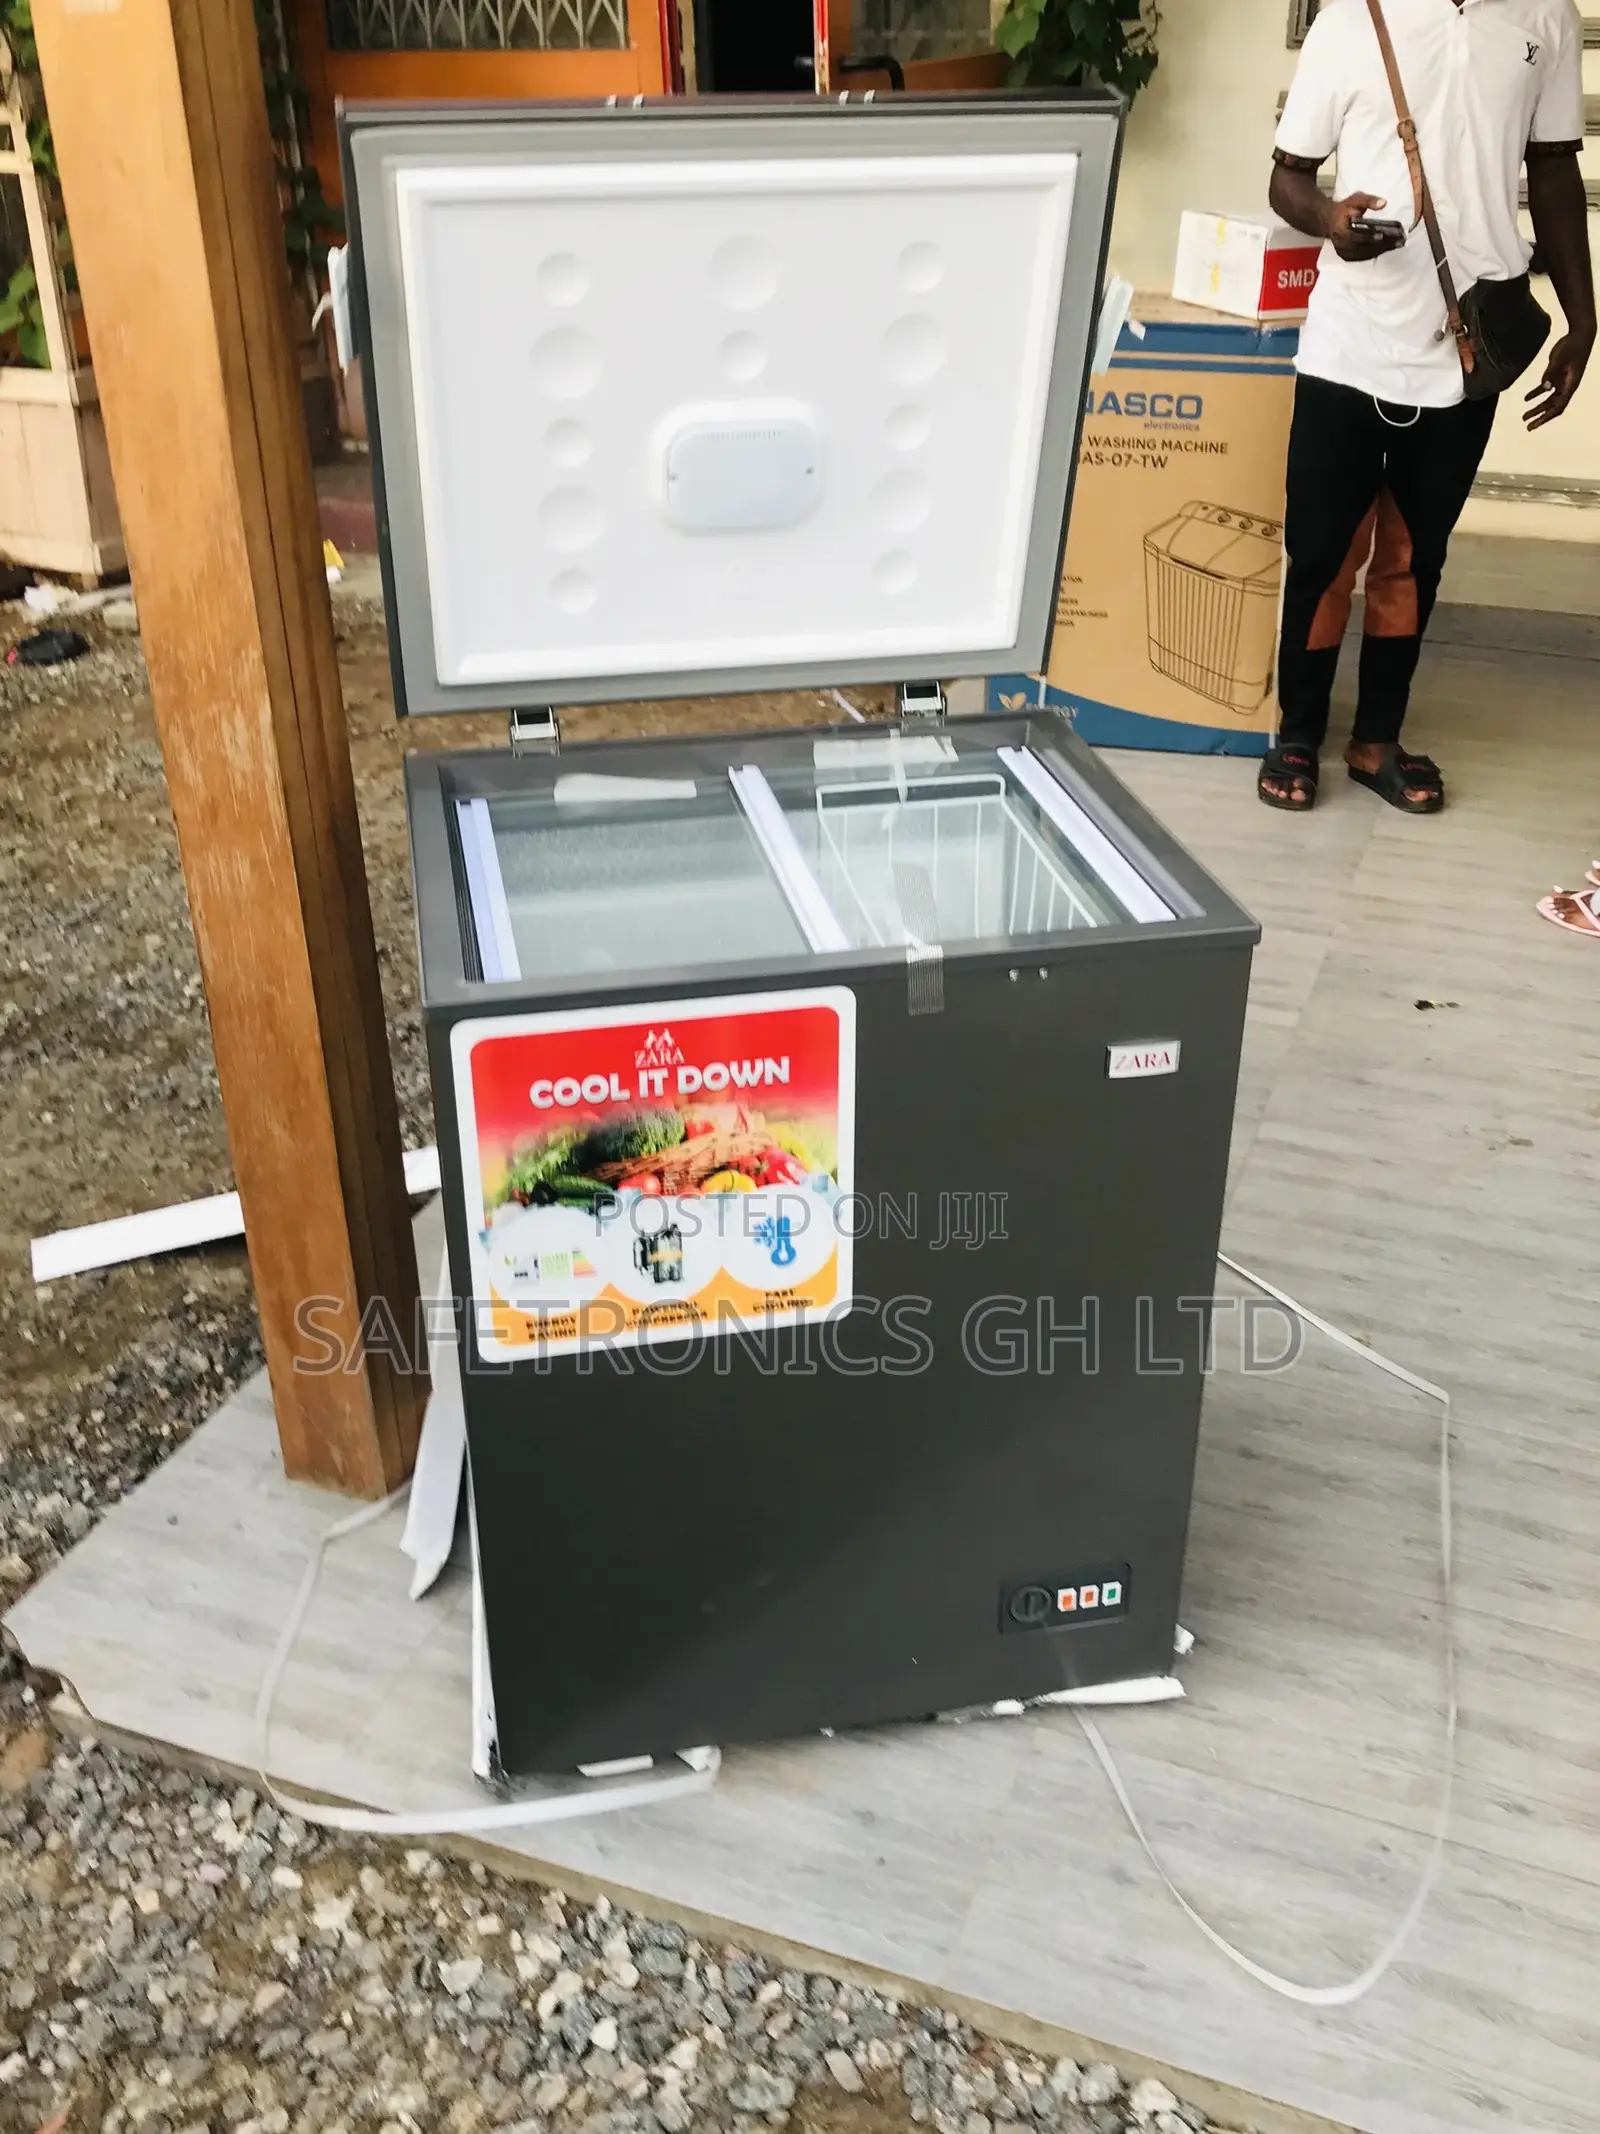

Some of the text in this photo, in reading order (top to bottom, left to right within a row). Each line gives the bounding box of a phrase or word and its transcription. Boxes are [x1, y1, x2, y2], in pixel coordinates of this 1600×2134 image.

[1277, 268, 1315, 289] SMD
[1088, 434, 1229, 455] WASHING MACHINE
[1080, 451, 1169, 469] AS-07-TW
[634, 1047, 685, 1068] ZARA
[1114, 1051, 1171, 1072] ZARA
[529, 1056, 790, 1109] COOL IT DOWN
